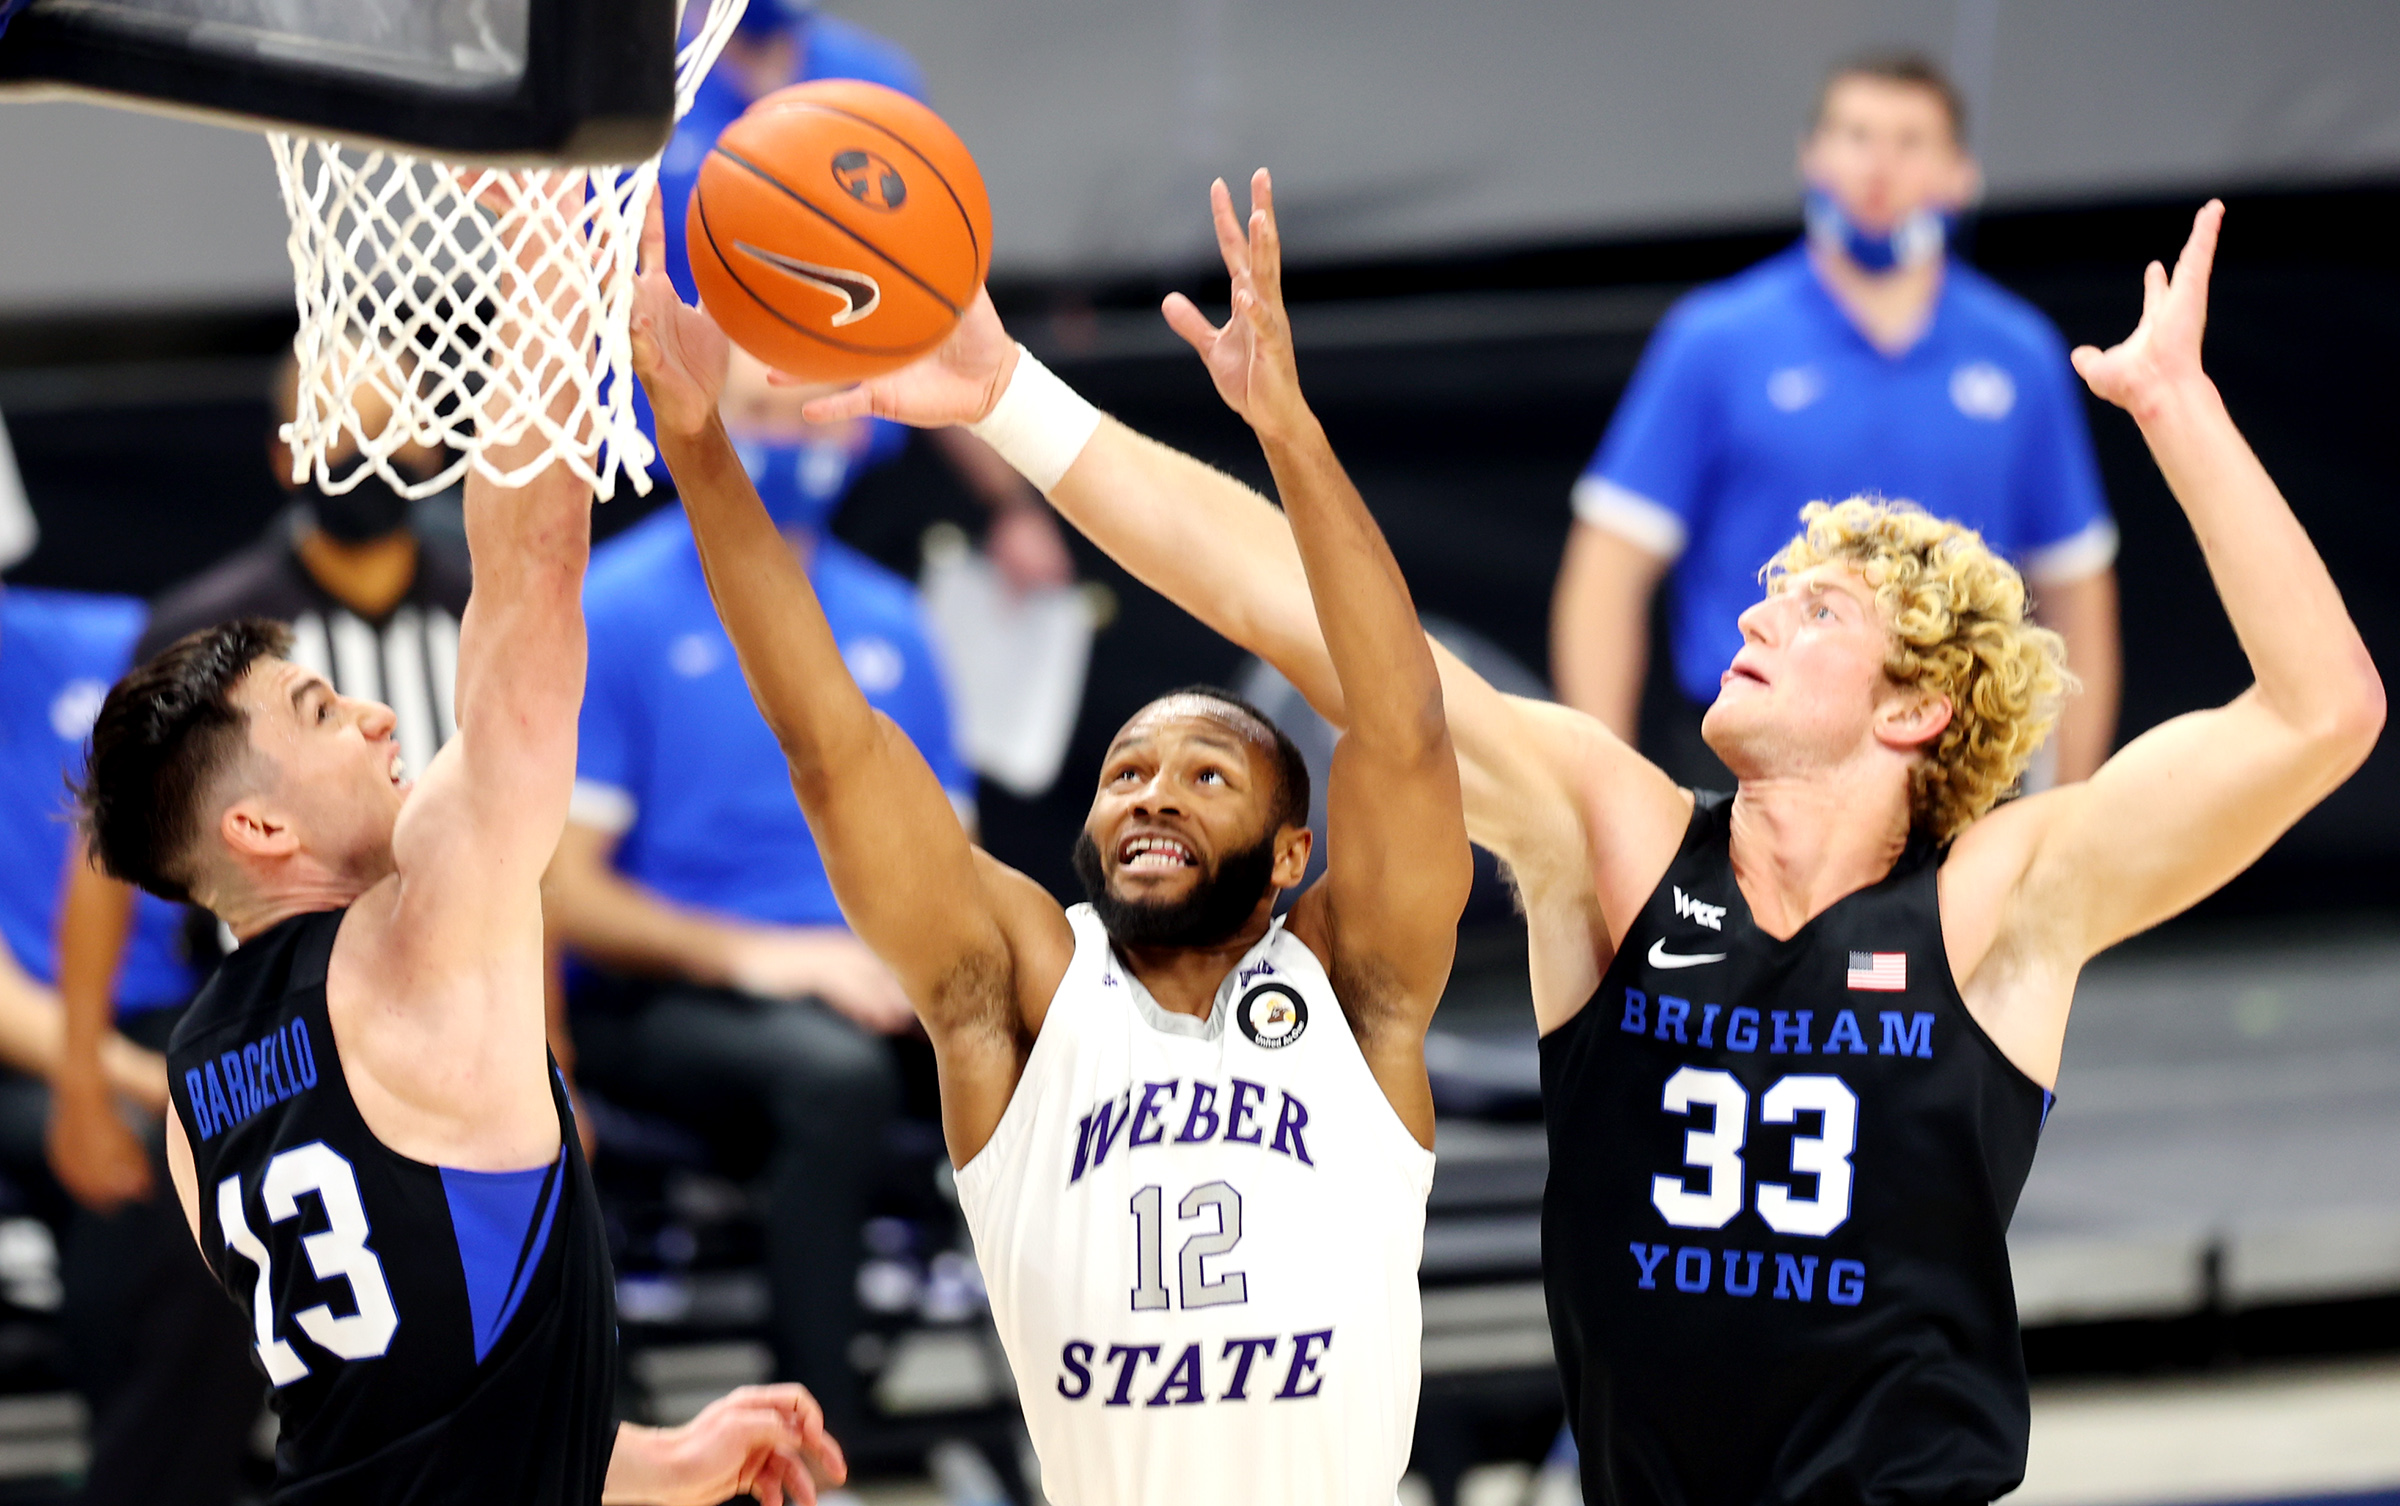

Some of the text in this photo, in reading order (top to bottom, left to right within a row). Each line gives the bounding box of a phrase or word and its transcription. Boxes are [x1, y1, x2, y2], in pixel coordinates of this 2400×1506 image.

[185, 1016, 318, 1141] BARCELLO
[1620, 986, 1936, 1059] BRIGHAM
[1067, 1077, 1316, 1189] WEBER
[1650, 1063, 1860, 1239] 33
[216, 1138, 400, 1389] 13
[1130, 1180, 1248, 1312] 12
[1629, 1242, 1867, 1306] YOUNG
[1057, 1325, 1336, 1408] STATE
